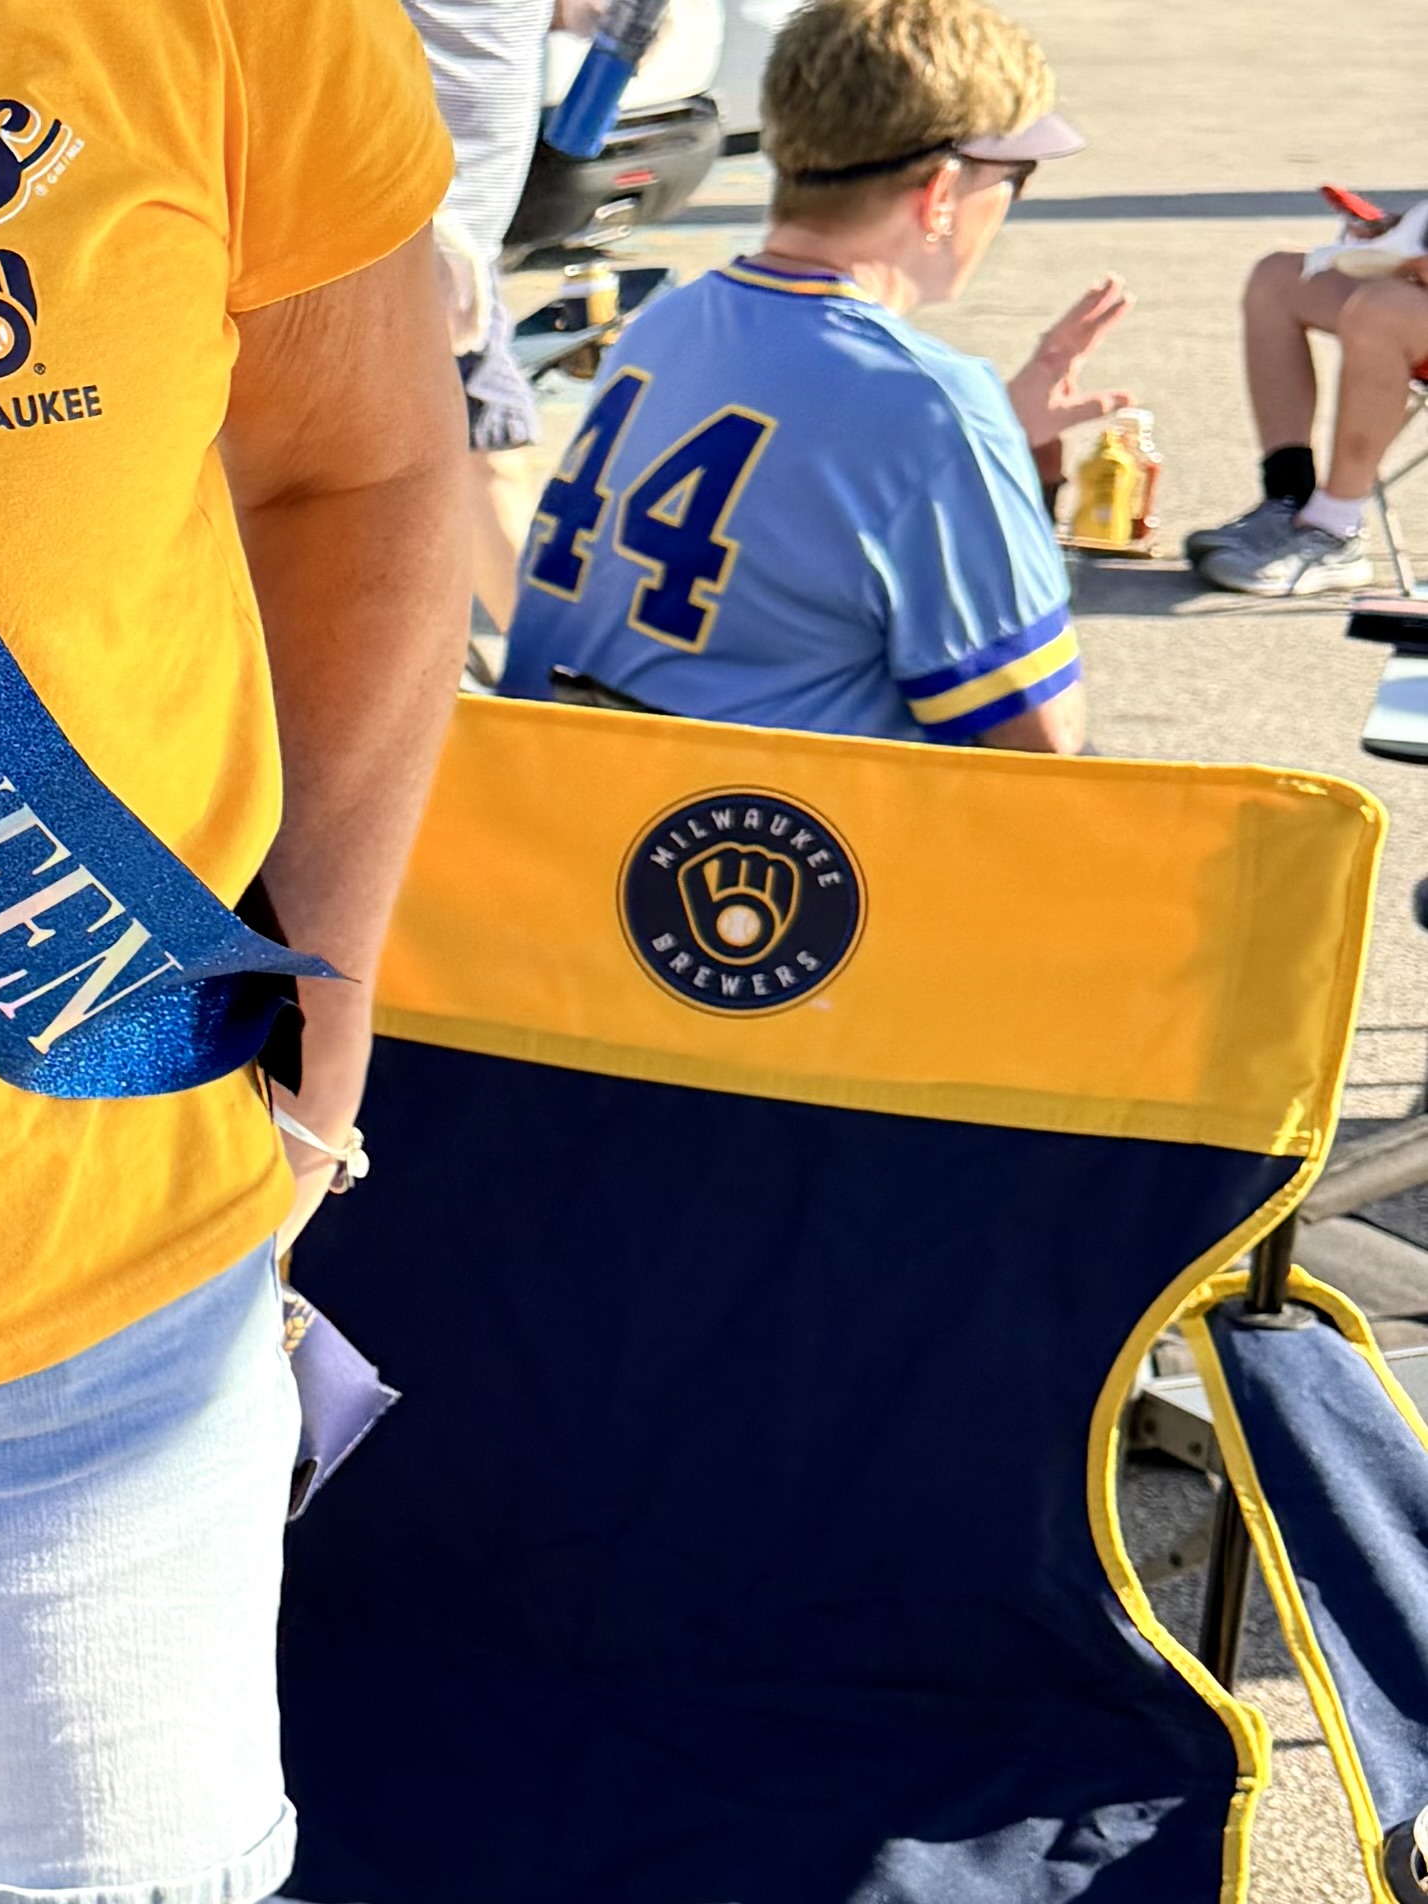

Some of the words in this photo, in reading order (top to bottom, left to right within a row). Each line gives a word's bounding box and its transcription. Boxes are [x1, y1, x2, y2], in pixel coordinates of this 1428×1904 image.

[526, 365, 777, 654] 44
[650, 807, 842, 888] MILWAUKEE
[652, 931, 821, 996] BREWERS
